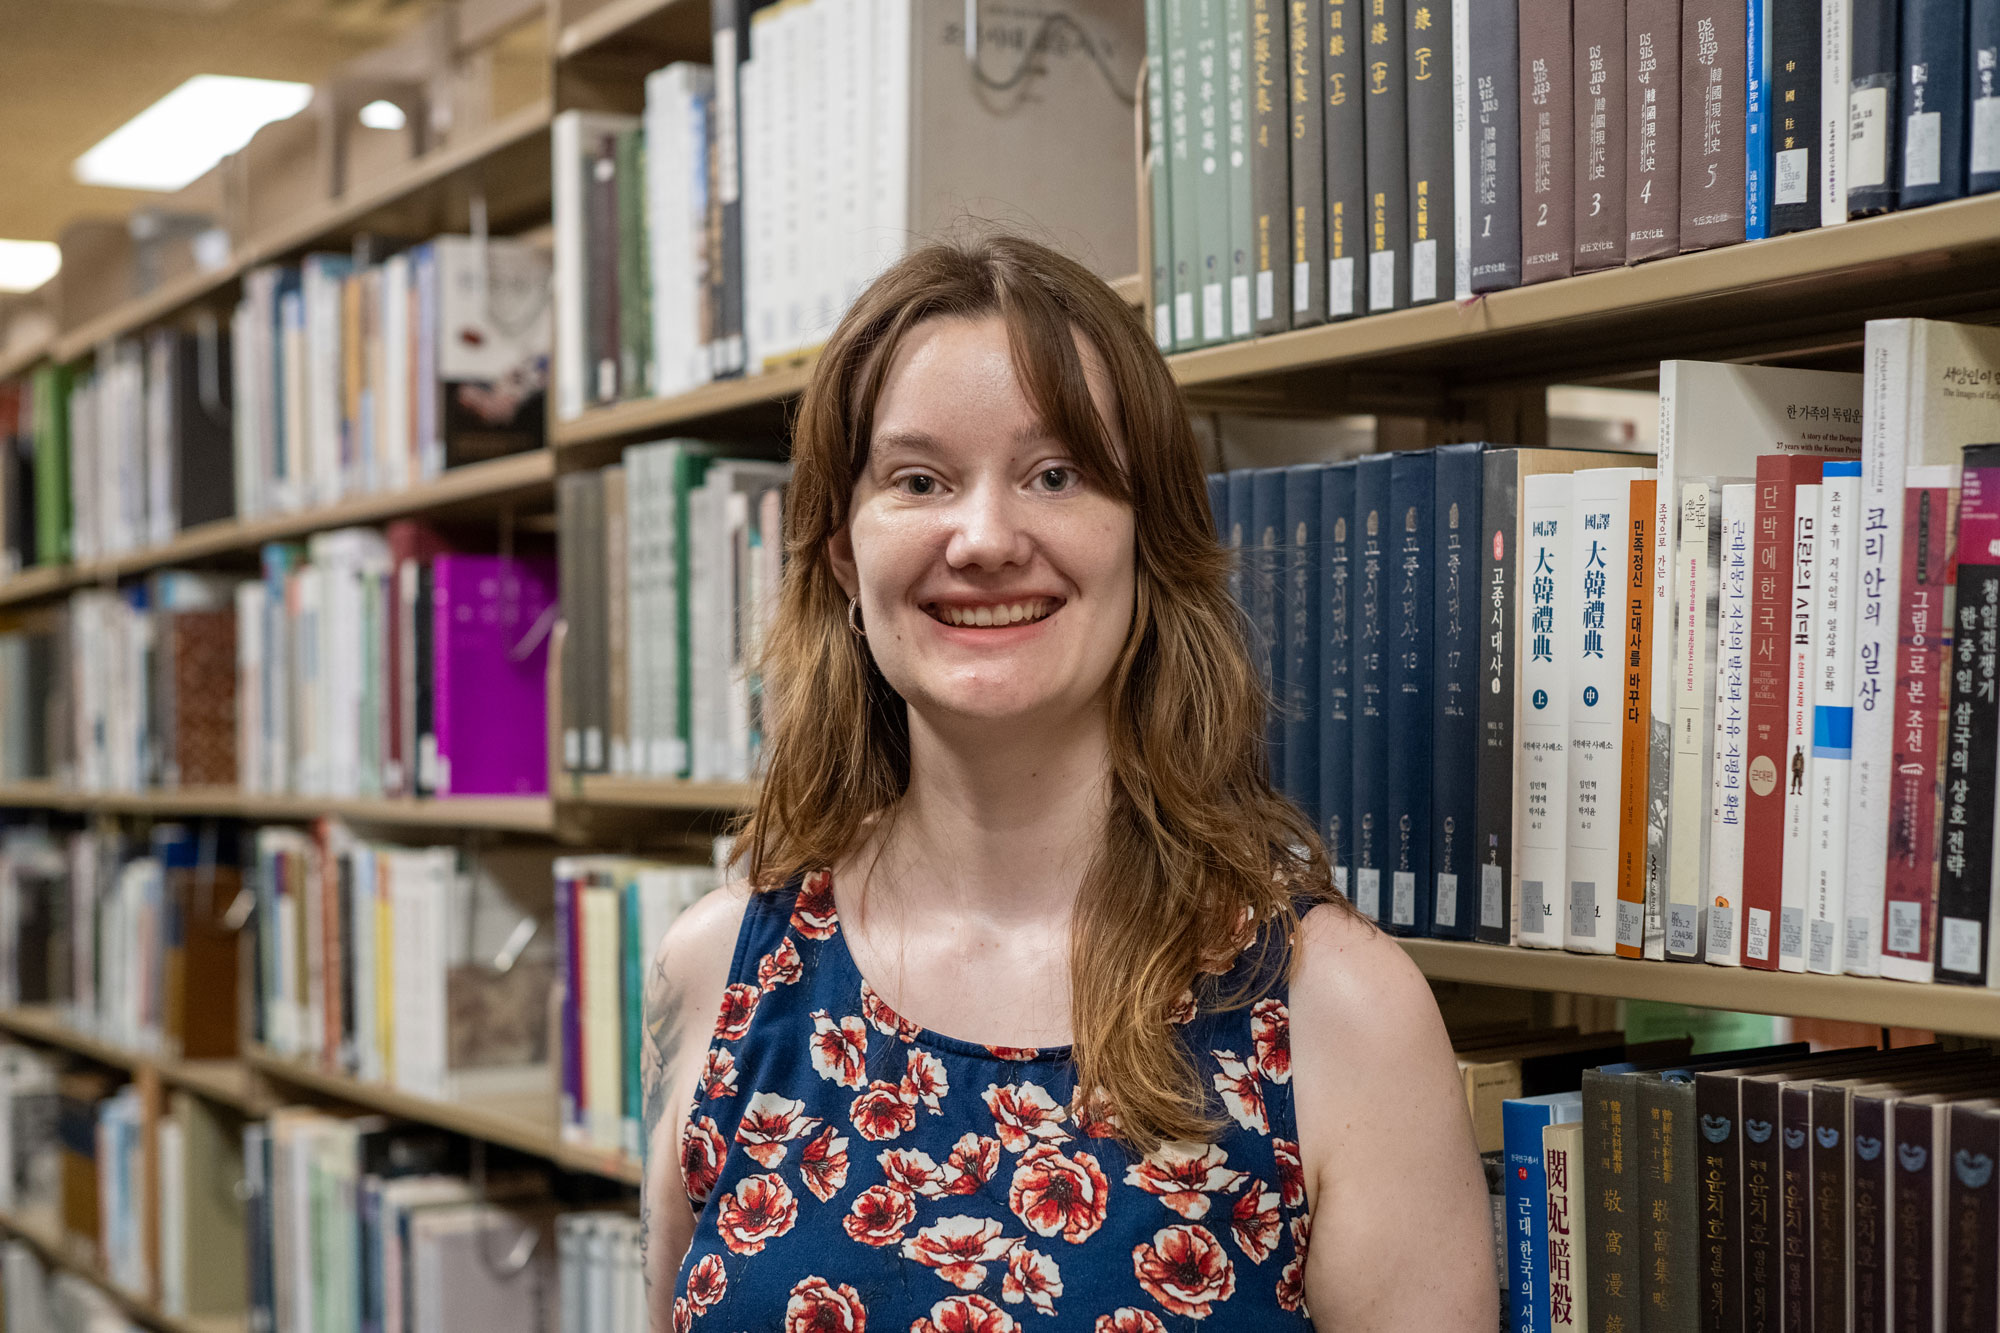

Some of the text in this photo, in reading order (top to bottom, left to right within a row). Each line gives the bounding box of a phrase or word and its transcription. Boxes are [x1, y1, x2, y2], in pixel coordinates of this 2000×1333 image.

[1589, 46, 1601, 59] DS
[1639, 33, 1651, 46] DS
[1640, 46, 1653, 59] 915
[1699, 32, 1714, 43] 915
[1590, 59, 1603, 70] 915
[1294, 115, 1306, 138] 5
[1705, 67, 1722, 187] 韓國現代史 5
[1540, 112, 1550, 193] 韓國現代史
[1590, 97, 1606, 216] 韓國現代史 3
[1641, 89, 1656, 203] 韓國現代史 4
[1485, 127, 1496, 204] 韓國現代史
[1482, 214, 1492, 238] 1
[1537, 204, 1548, 226] 2
[1580, 242, 1614, 253] 新丘文化社
[1630, 229, 1664, 241] 新丘文化社
[1943, 388, 1955, 398] The
[1944, 367, 1992, 386] 서양인이
[1787, 404, 1863, 425] 한 가족의 독립운
[1776, 441, 1844, 453] 27 years with the Korean
[1801, 432, 1838, 443] A story of the
[1585, 513, 1610, 531] 國譯
[1685, 499, 1695, 522] 현실
[1695, 494, 1706, 531] 이념과
[1532, 520, 1558, 537] 國譯
[1657, 503, 1668, 598] 조국으로 가는 길
[1864, 507, 1888, 627] 코리안의
[1401, 537, 1420, 641] 고종시대사
[1446, 535, 1462, 640] 고종시대사
[1758, 485, 1778, 661] 단박에 한국사
[1795, 516, 1813, 645] 민란의 시대
[1332, 547, 1348, 648] 고종시대사
[1363, 540, 1380, 643] 고종시대사
[1532, 546, 1556, 663] 大韓禮典
[1582, 540, 1607, 659] 大韓禮典
[1825, 491, 1841, 693] 조선 후기 지식인의 일상과 문화
[1490, 568, 1504, 677] 고종시대사
[1628, 519, 1645, 724] 민족정신 근대사를 바꾸다
[1909, 591, 1930, 675] 그림으로
[1977, 579, 1999, 704] 청일전쟁기
[1331, 658, 1348, 675] 14
[1448, 651, 1461, 669] 17
[1688, 664, 1694, 677] 다시
[1723, 519, 1746, 825] 근대계몽기 지식의 발견과 사유 지평의 확대
[1797, 653, 1805, 679] 조선의
[1859, 641, 1881, 712] 일상
[1753, 677, 1778, 685] HISTORY
[1755, 691, 1776, 700] KOREA
[1796, 682, 1804, 707] 마지막
[1907, 680, 1926, 704] 본
[1592, 740, 1613, 750] 사례소
[1905, 709, 1924, 753] 조선
[1951, 701, 1974, 774] 삼국의
[1751, 769, 1773, 782] 근대편
[1529, 807, 1547, 817] 박지윤
[1578, 806, 1597, 817] 박지윤
[1949, 778, 1970, 825] 상호
[1946, 829, 1966, 879] 전략
[1672, 919, 1690, 928] 915.2
[1671, 939, 1685, 949] 2024
[1511, 1153, 1539, 1165] 한국연구총서
[1517, 1167, 1528, 1180] 74
[1518, 1197, 1532, 1237] 근대
[1706, 1169, 1727, 1241] 윤치호
[1748, 1174, 1769, 1246] 윤치호
[1784, 1183, 1804, 1258] 윤치호
[1547, 1149, 1572, 1326] 閔妃暗殺
[1519, 1240, 1534, 1301] 한국의
[1710, 1245, 1726, 1279] 영문
[1711, 1282, 1723, 1316] 일기
[1753, 1287, 1766, 1322] 일기
